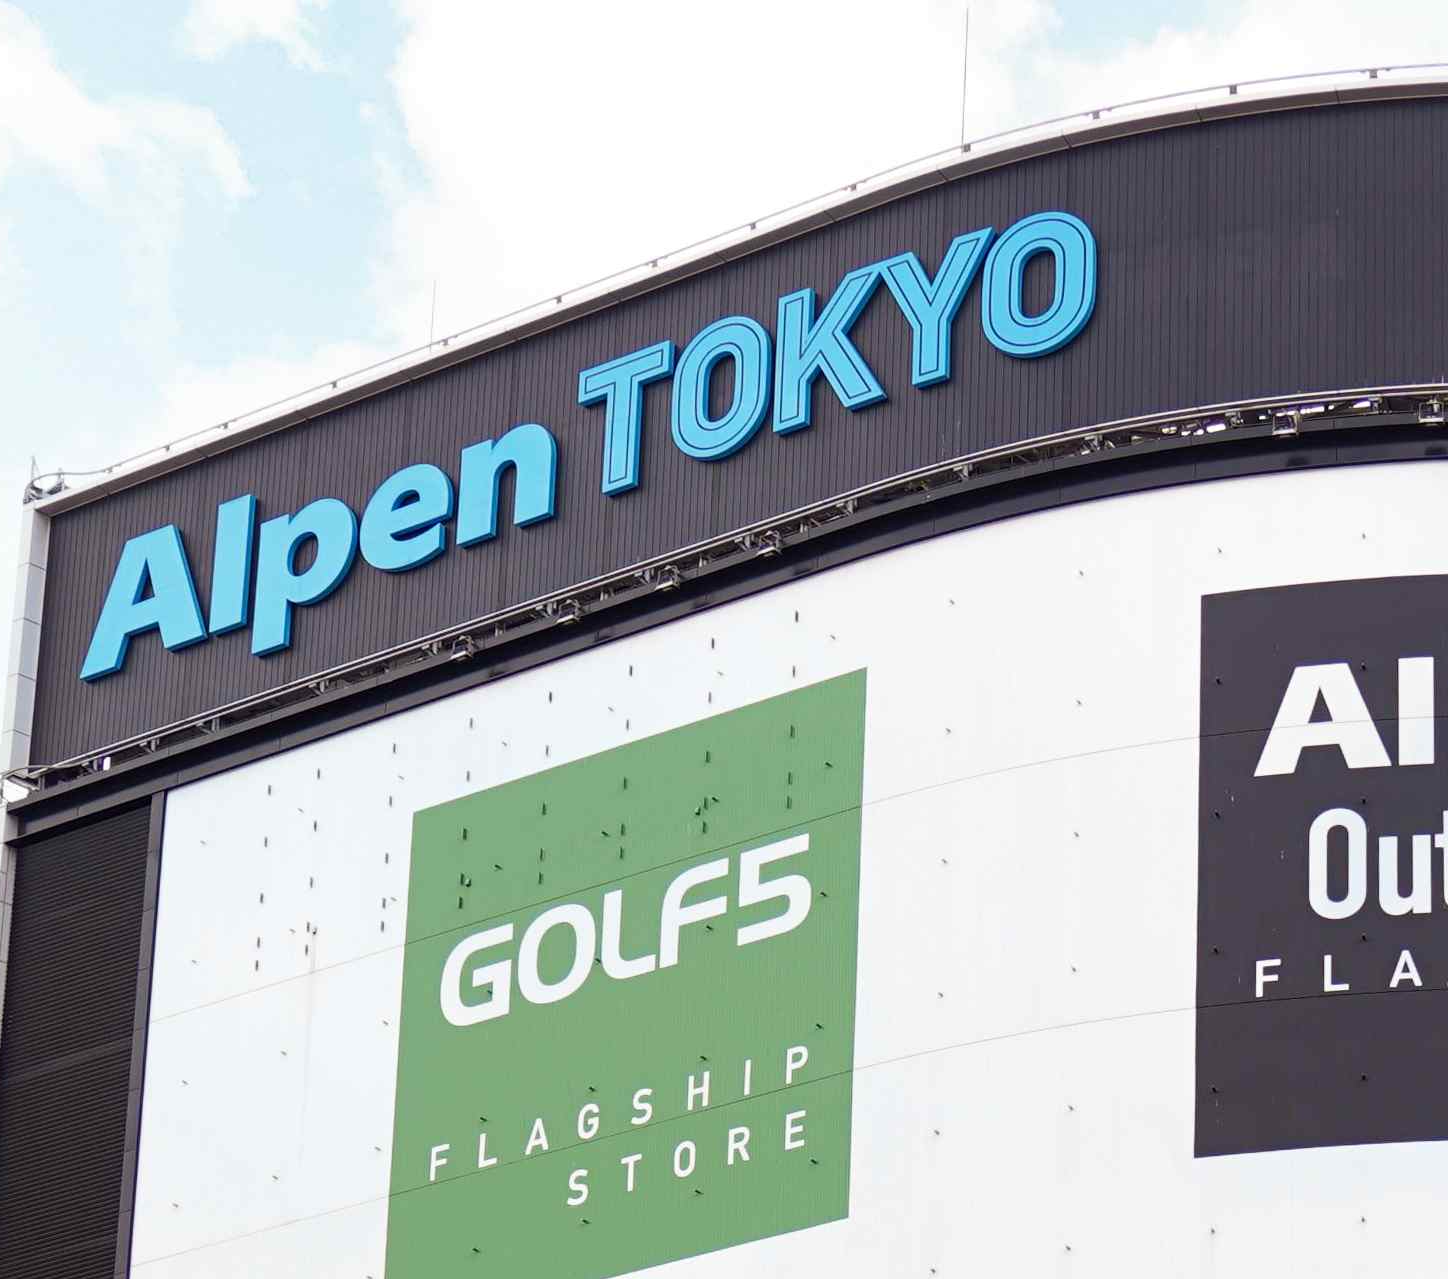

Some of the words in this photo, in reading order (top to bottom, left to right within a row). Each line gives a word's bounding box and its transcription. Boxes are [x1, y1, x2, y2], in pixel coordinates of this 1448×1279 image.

[80, 423, 558, 681] Alpen
[577, 211, 1097, 496] TOKYO
[439, 833, 813, 1028] GOLF5
[428, 1044, 809, 1182] FLAGSHIP
[567, 1109, 807, 1208] STORE
